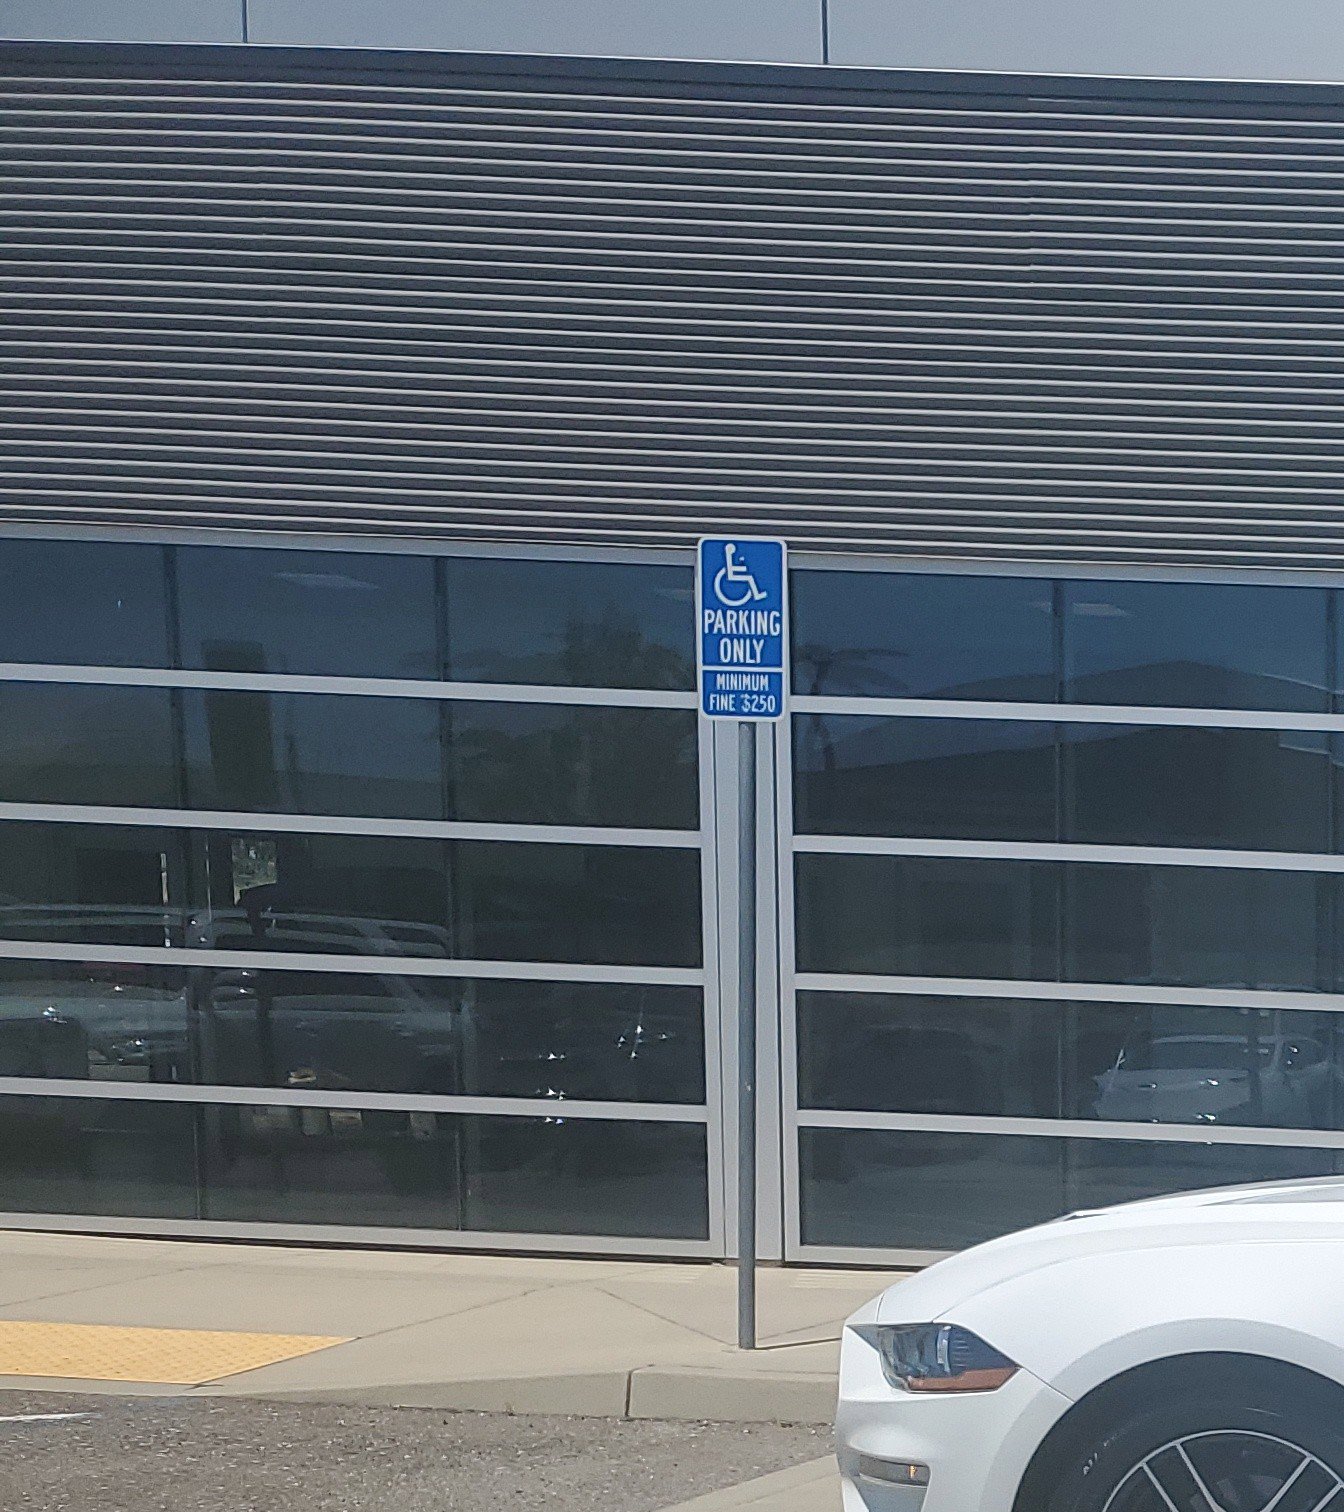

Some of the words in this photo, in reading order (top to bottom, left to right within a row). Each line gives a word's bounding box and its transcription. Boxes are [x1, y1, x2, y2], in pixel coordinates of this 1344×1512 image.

[704, 609, 780, 636] PARKING
[719, 638, 764, 664] ONLY
[716, 673, 769, 691] MINIMUM
[709, 693, 736, 711] FINE
[740, 693, 775, 713] $250
